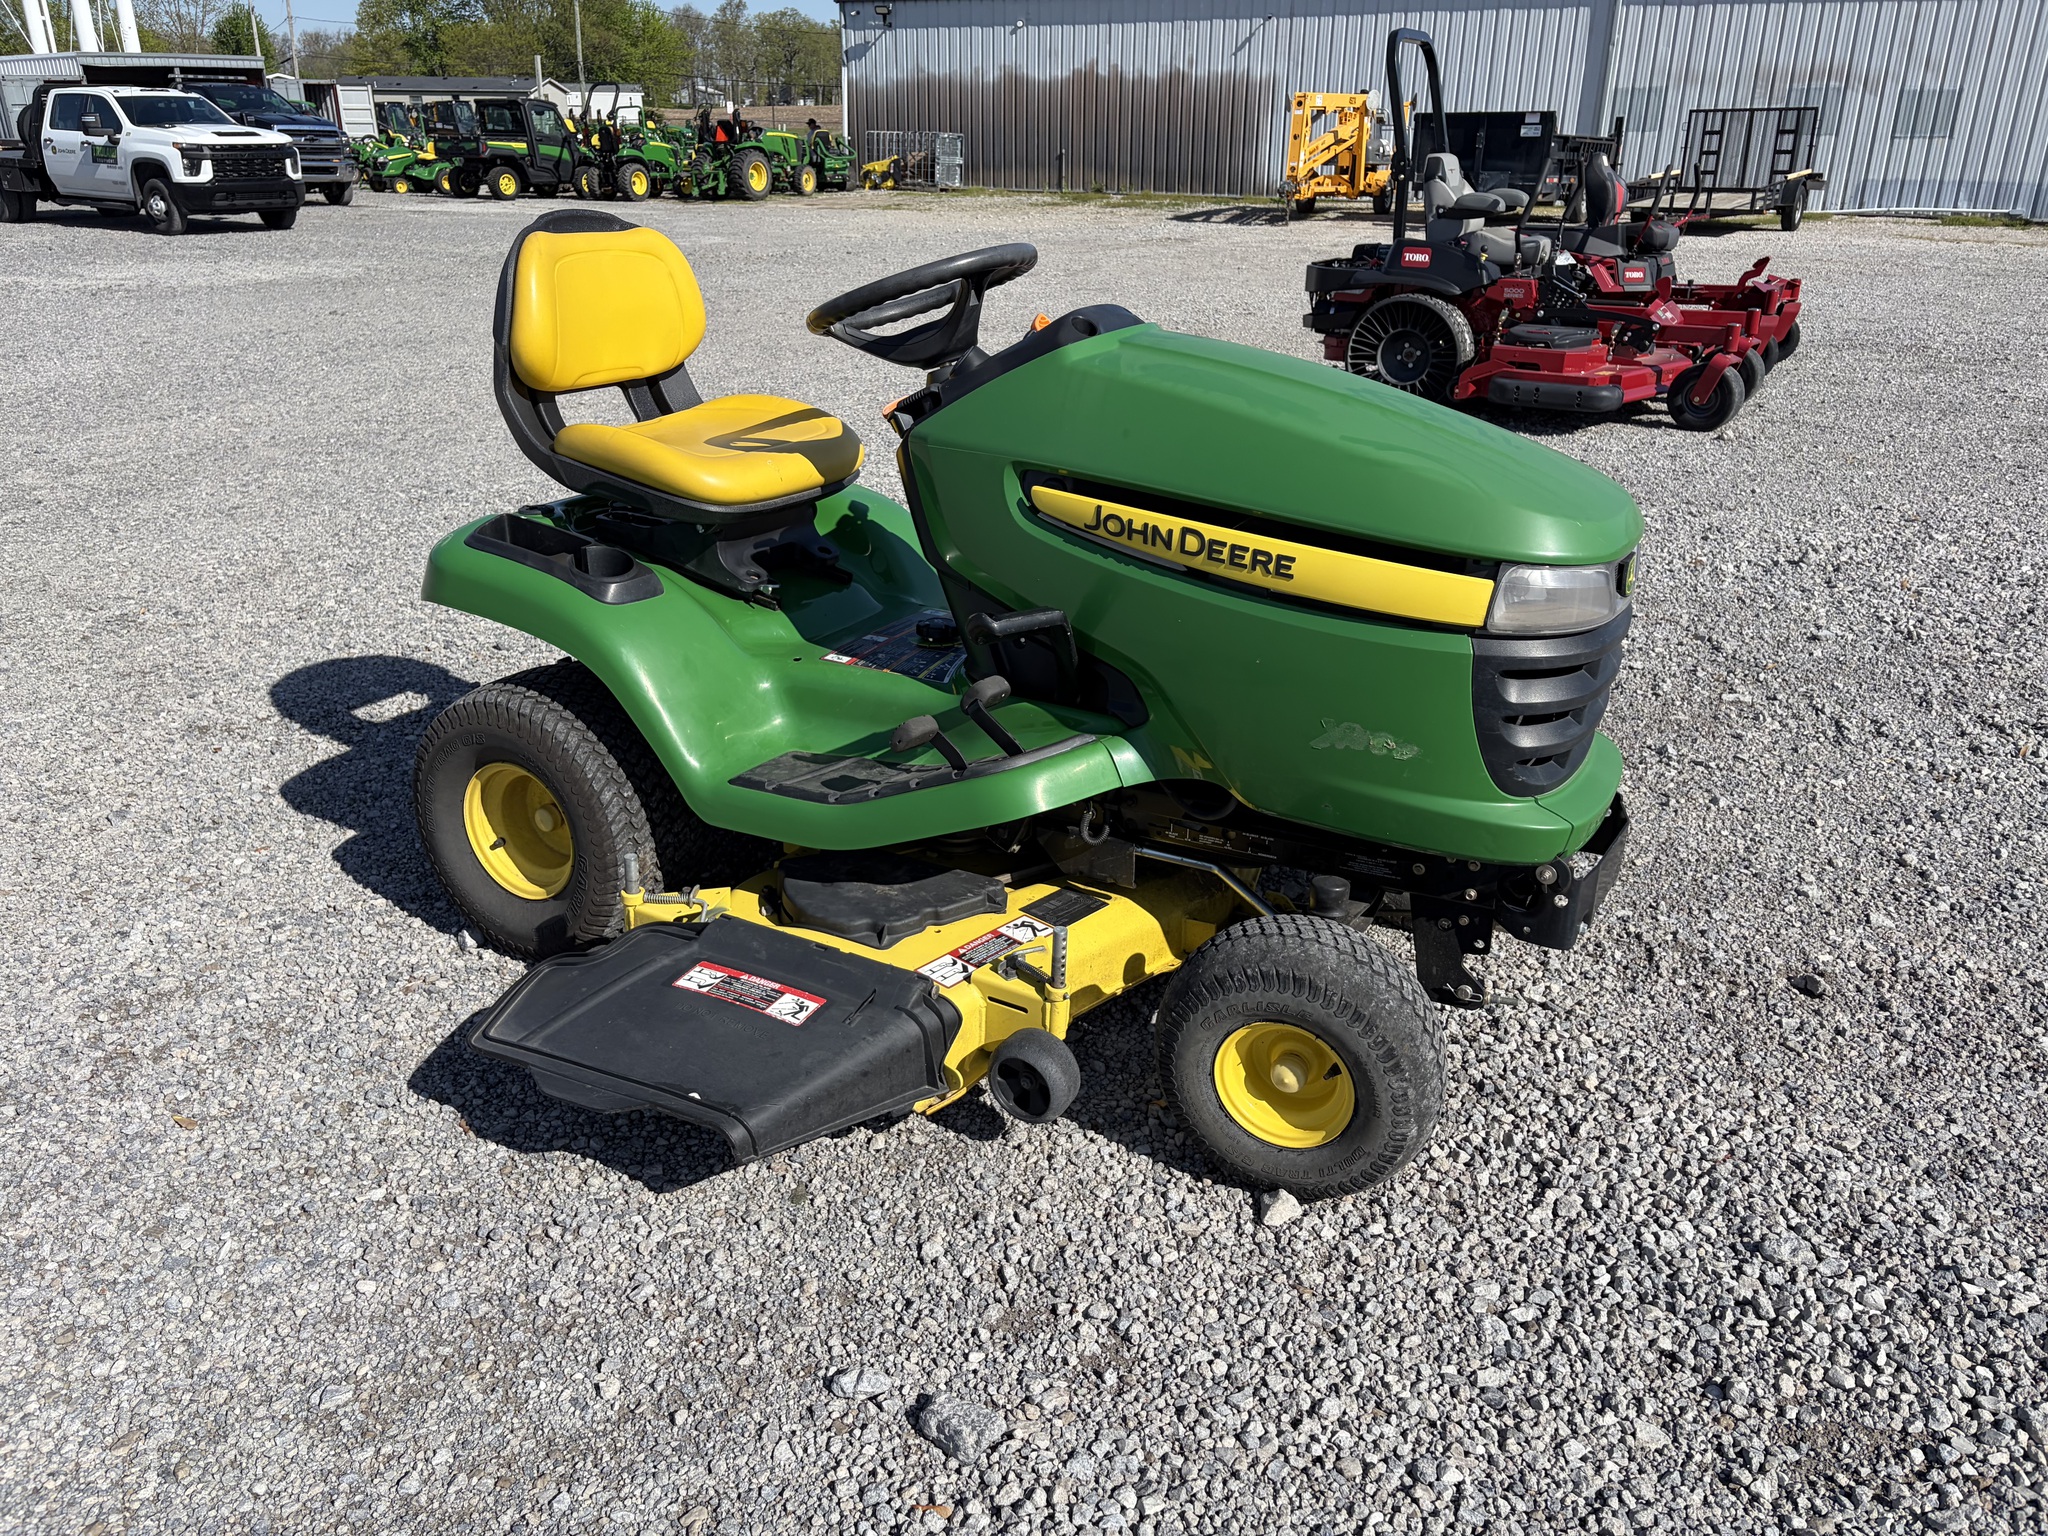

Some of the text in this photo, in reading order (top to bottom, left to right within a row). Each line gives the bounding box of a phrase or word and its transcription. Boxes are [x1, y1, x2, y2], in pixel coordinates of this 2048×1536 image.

[1625, 271, 1644, 279] TORO
[1083, 504, 1297, 581] JOHN DEERE
[964, 933, 996, 951] DANGER
[748, 974, 782, 990] DANGER
[675, 1001, 769, 1040] DO NOT REMOVE
[1200, 1000, 1314, 1032] CARLISLE
[1261, 1164, 1313, 1181] TRAC
[1318, 1145, 1367, 1178] MULTI
